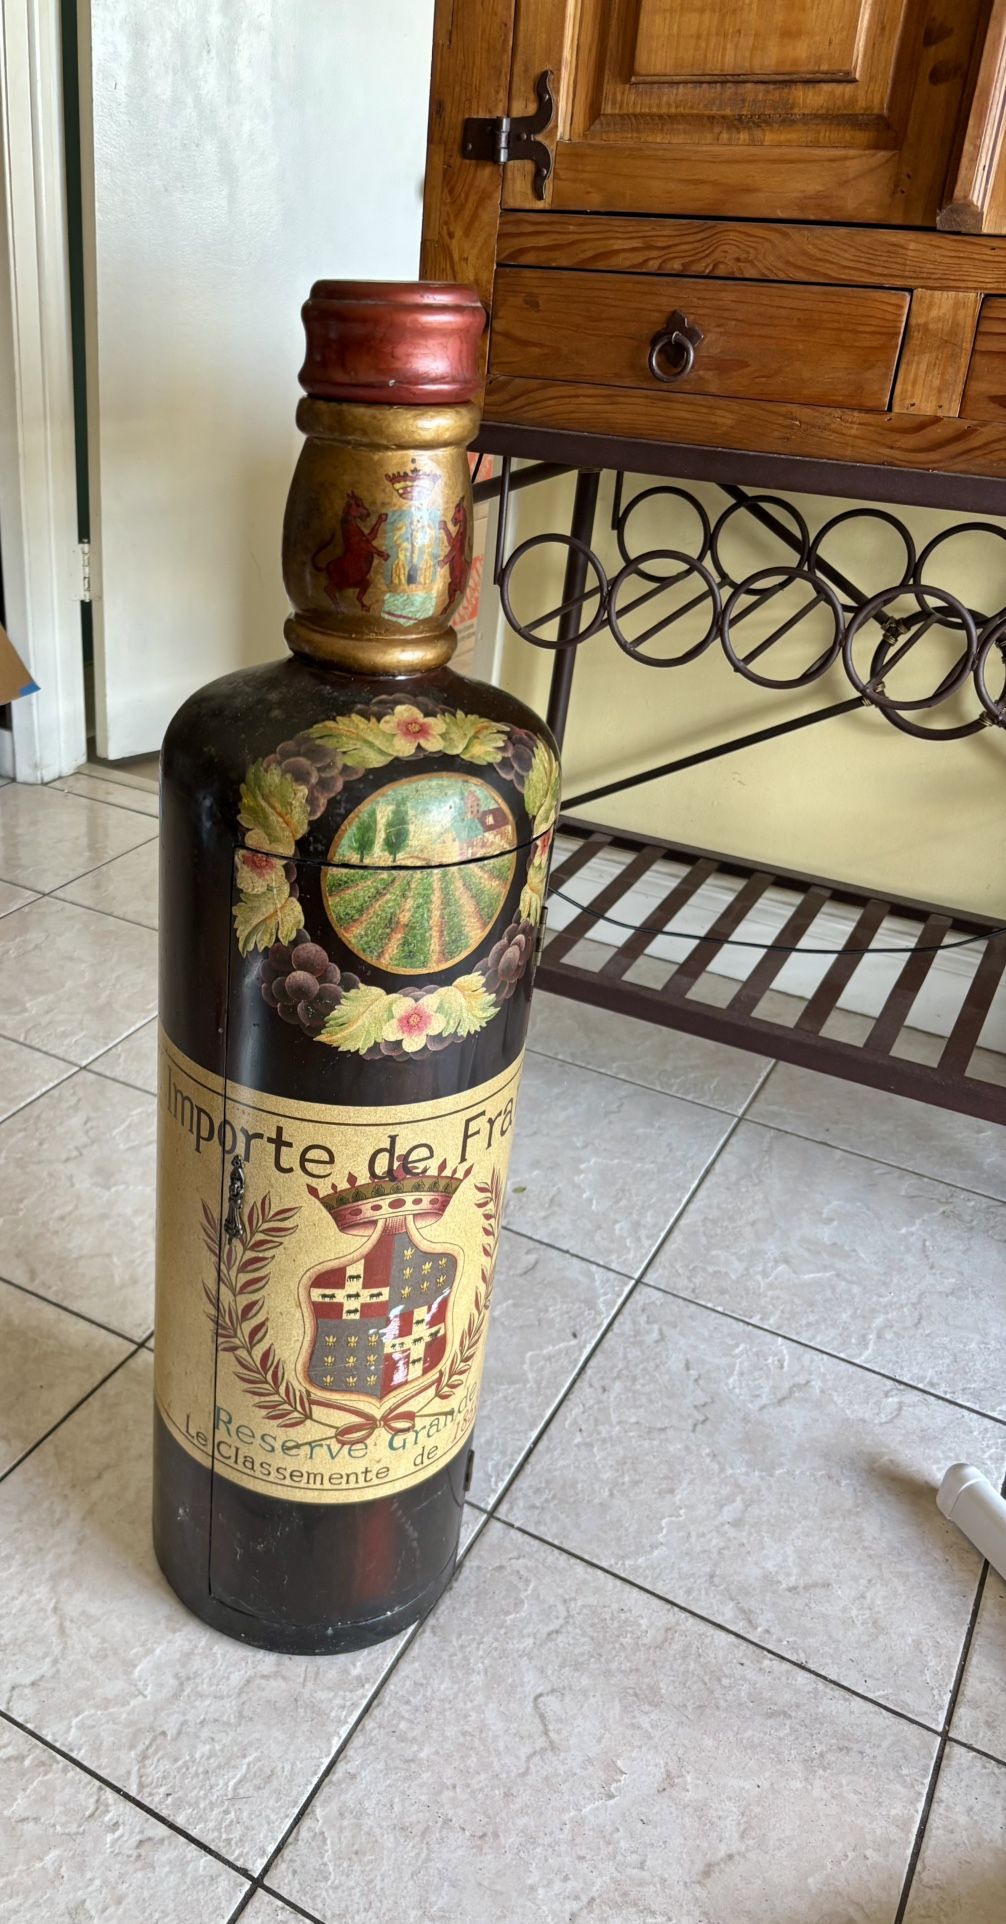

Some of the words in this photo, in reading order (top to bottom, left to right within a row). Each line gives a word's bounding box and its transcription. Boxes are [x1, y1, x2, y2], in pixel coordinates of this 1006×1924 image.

[168, 1064, 335, 1179] Importe
[368, 1134, 434, 1182] de
[458, 1088, 518, 1165] Fra
[185, 1411, 209, 1447] Le
[216, 1440, 390, 1486] Classemente
[413, 1444, 439, 1467] de
[215, 1404, 369, 1460] Reserve
